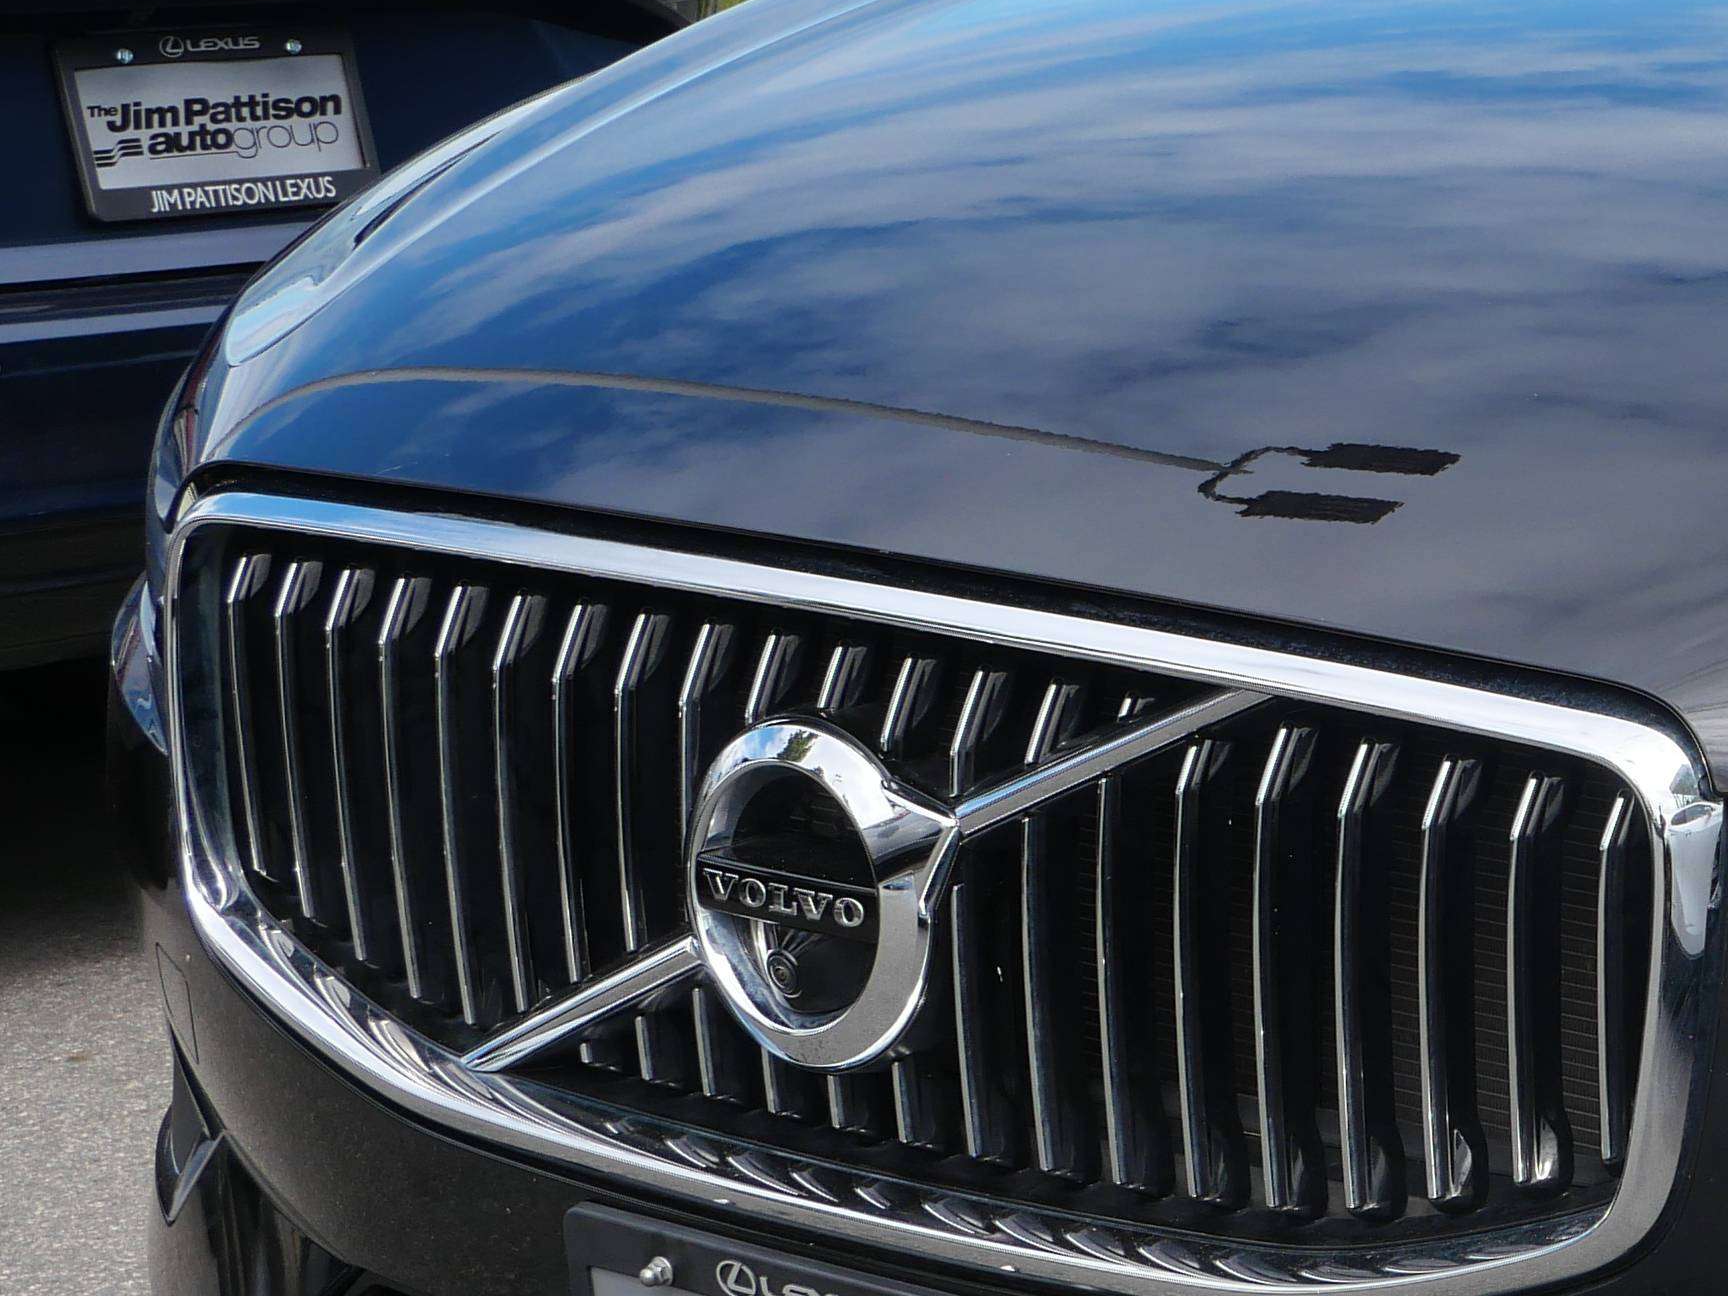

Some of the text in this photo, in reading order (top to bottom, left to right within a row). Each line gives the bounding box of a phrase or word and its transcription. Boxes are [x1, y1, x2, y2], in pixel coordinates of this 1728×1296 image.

[187, 35, 260, 53] LEXUS
[87, 93, 343, 134] The Jim Pattison
[149, 118, 340, 158] autogroup
[151, 176, 337, 214] JIM PATTISON LEXUS
[703, 867, 865, 929] VOLVO
